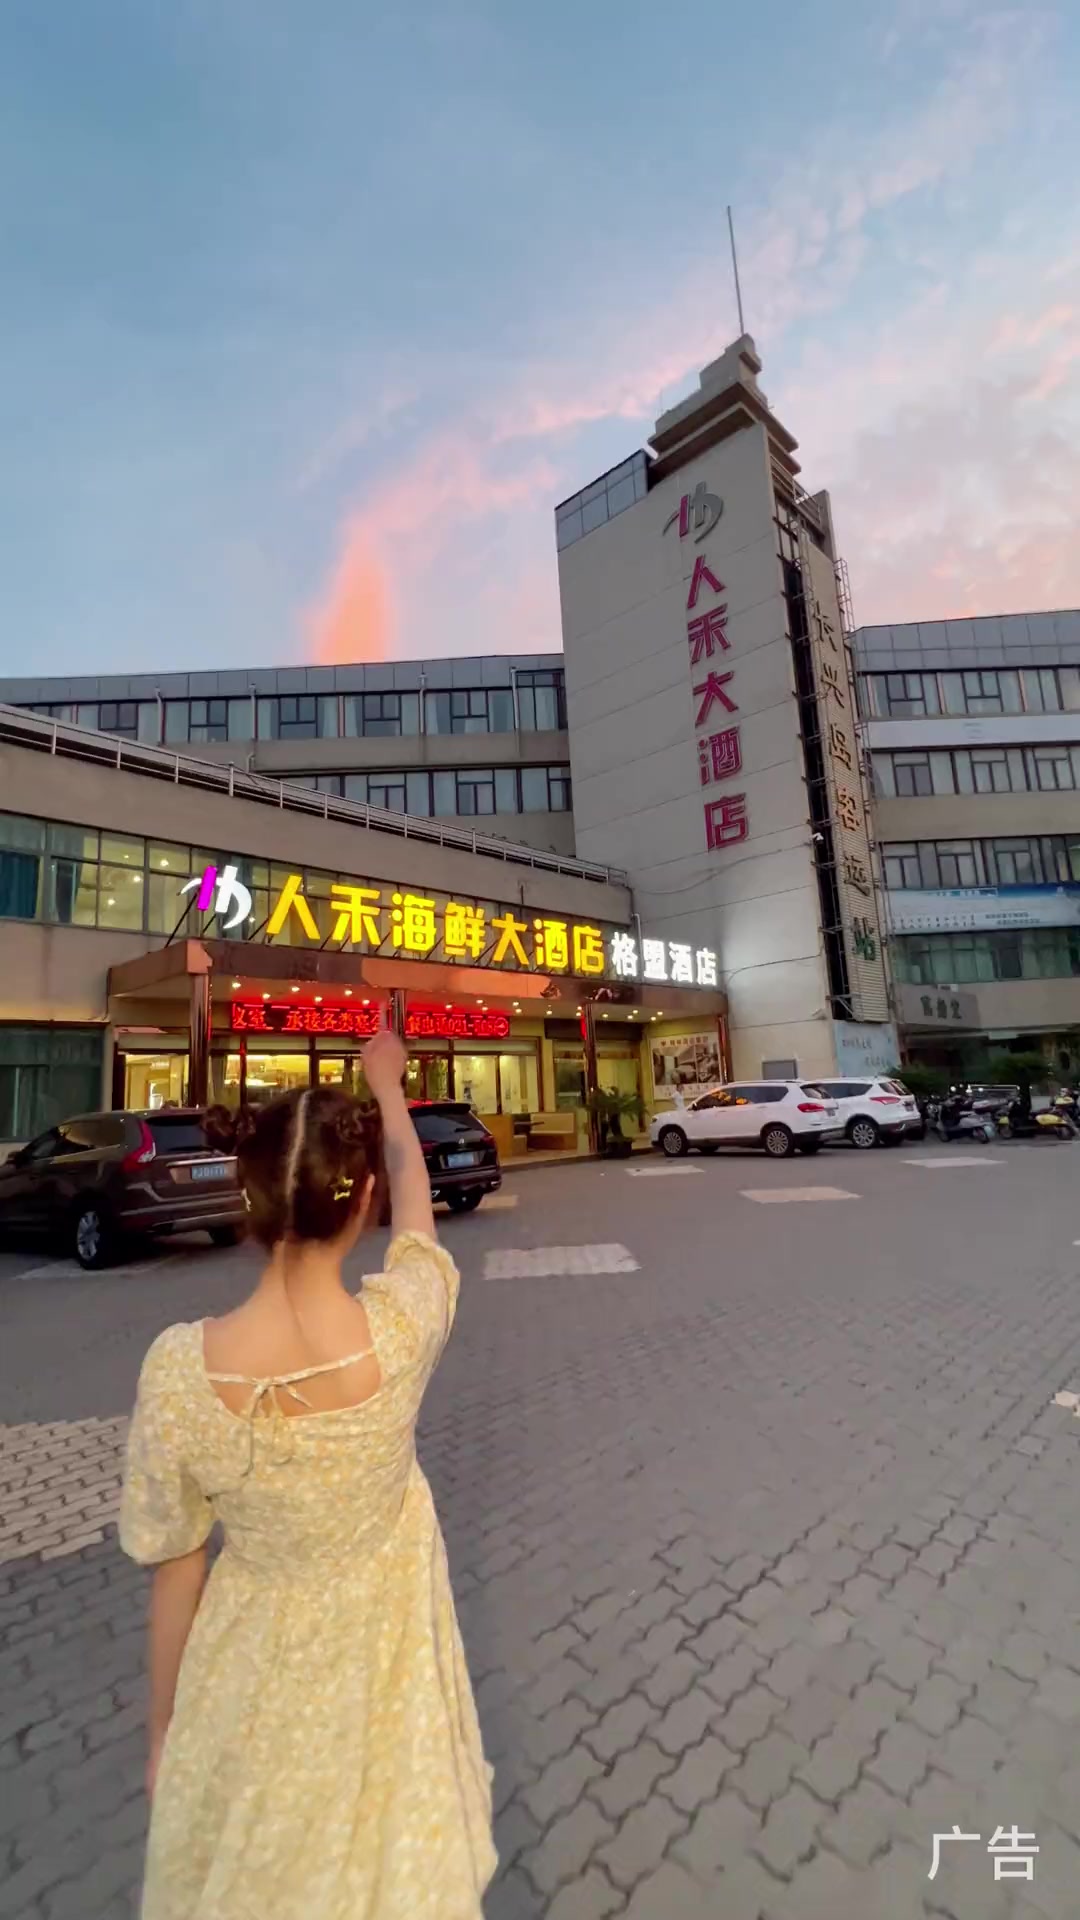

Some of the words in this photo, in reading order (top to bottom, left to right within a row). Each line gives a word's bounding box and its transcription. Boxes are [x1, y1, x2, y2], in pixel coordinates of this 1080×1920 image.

[687, 554, 749, 852] 人禾大酒店
[267, 874, 605, 974] 人禾海鲜大酒店
[611, 931, 718, 986] 格盟酒店
